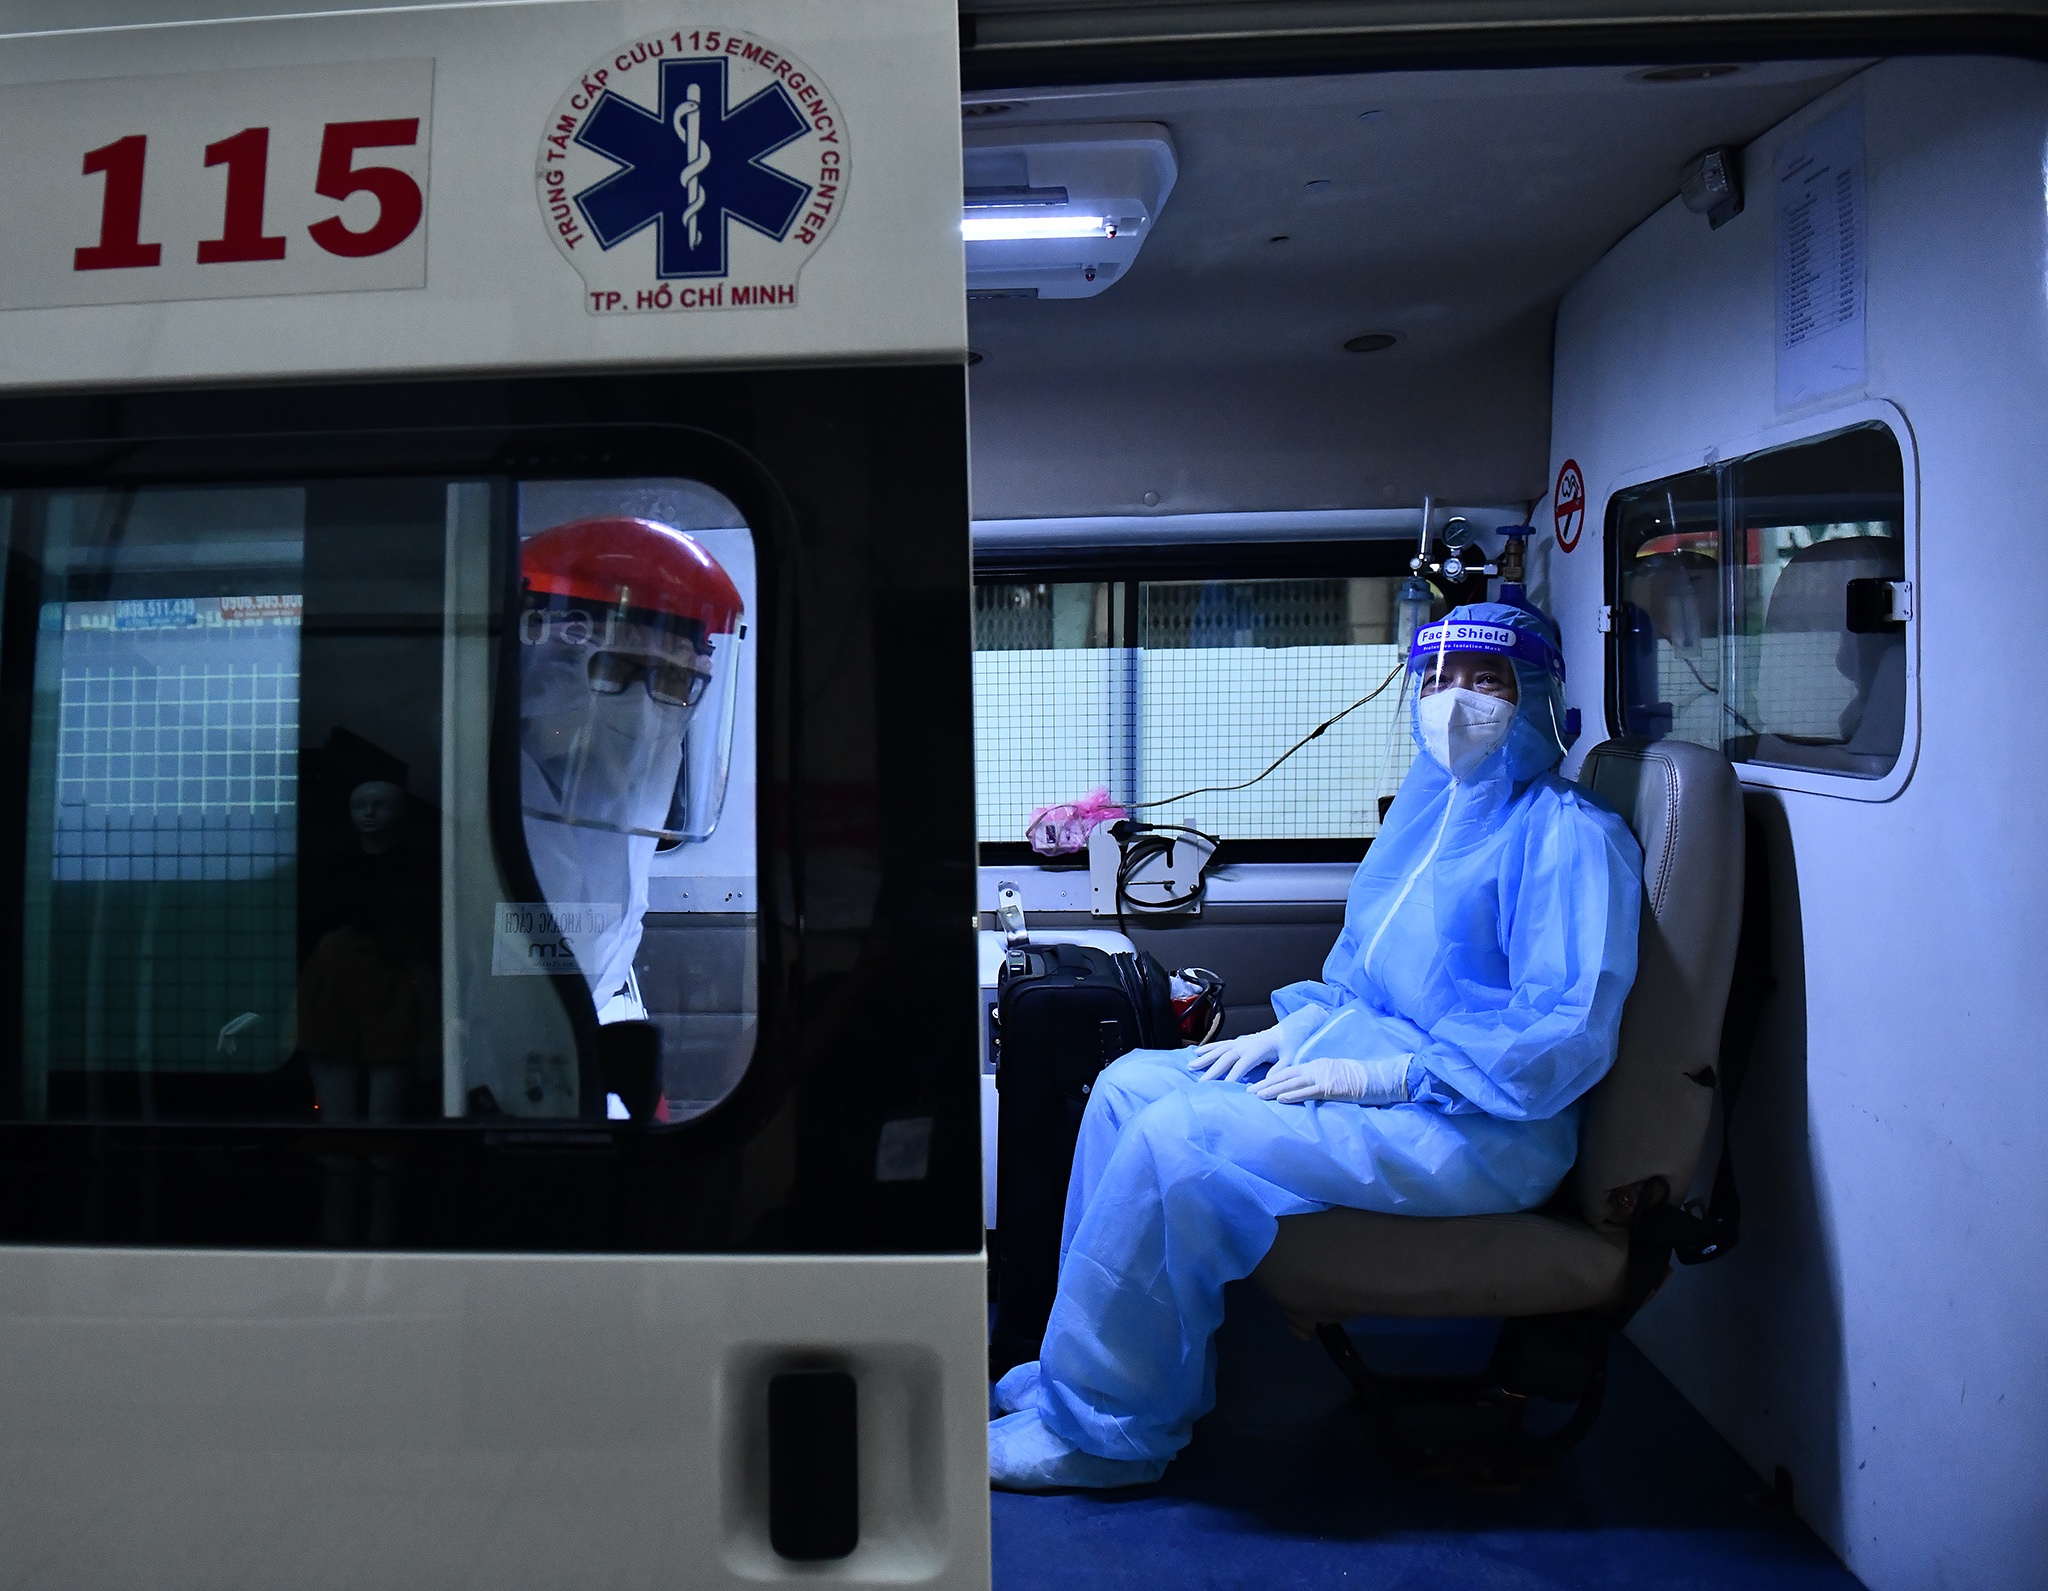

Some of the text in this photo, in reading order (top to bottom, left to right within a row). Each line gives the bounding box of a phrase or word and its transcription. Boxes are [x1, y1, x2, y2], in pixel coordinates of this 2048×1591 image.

[670, 31, 721, 52] 115
[546, 114, 578, 162] TÂM
[724, 37, 840, 245] EMERGENCY CENTER
[73, 117, 423, 271] 115
[545, 169, 585, 250] TRUNG
[589, 291, 628, 311] TP.
[679, 282, 724, 308] CHÍ
[731, 284, 795, 305] MINH
[1422, 627, 1509, 643] Face Shield
